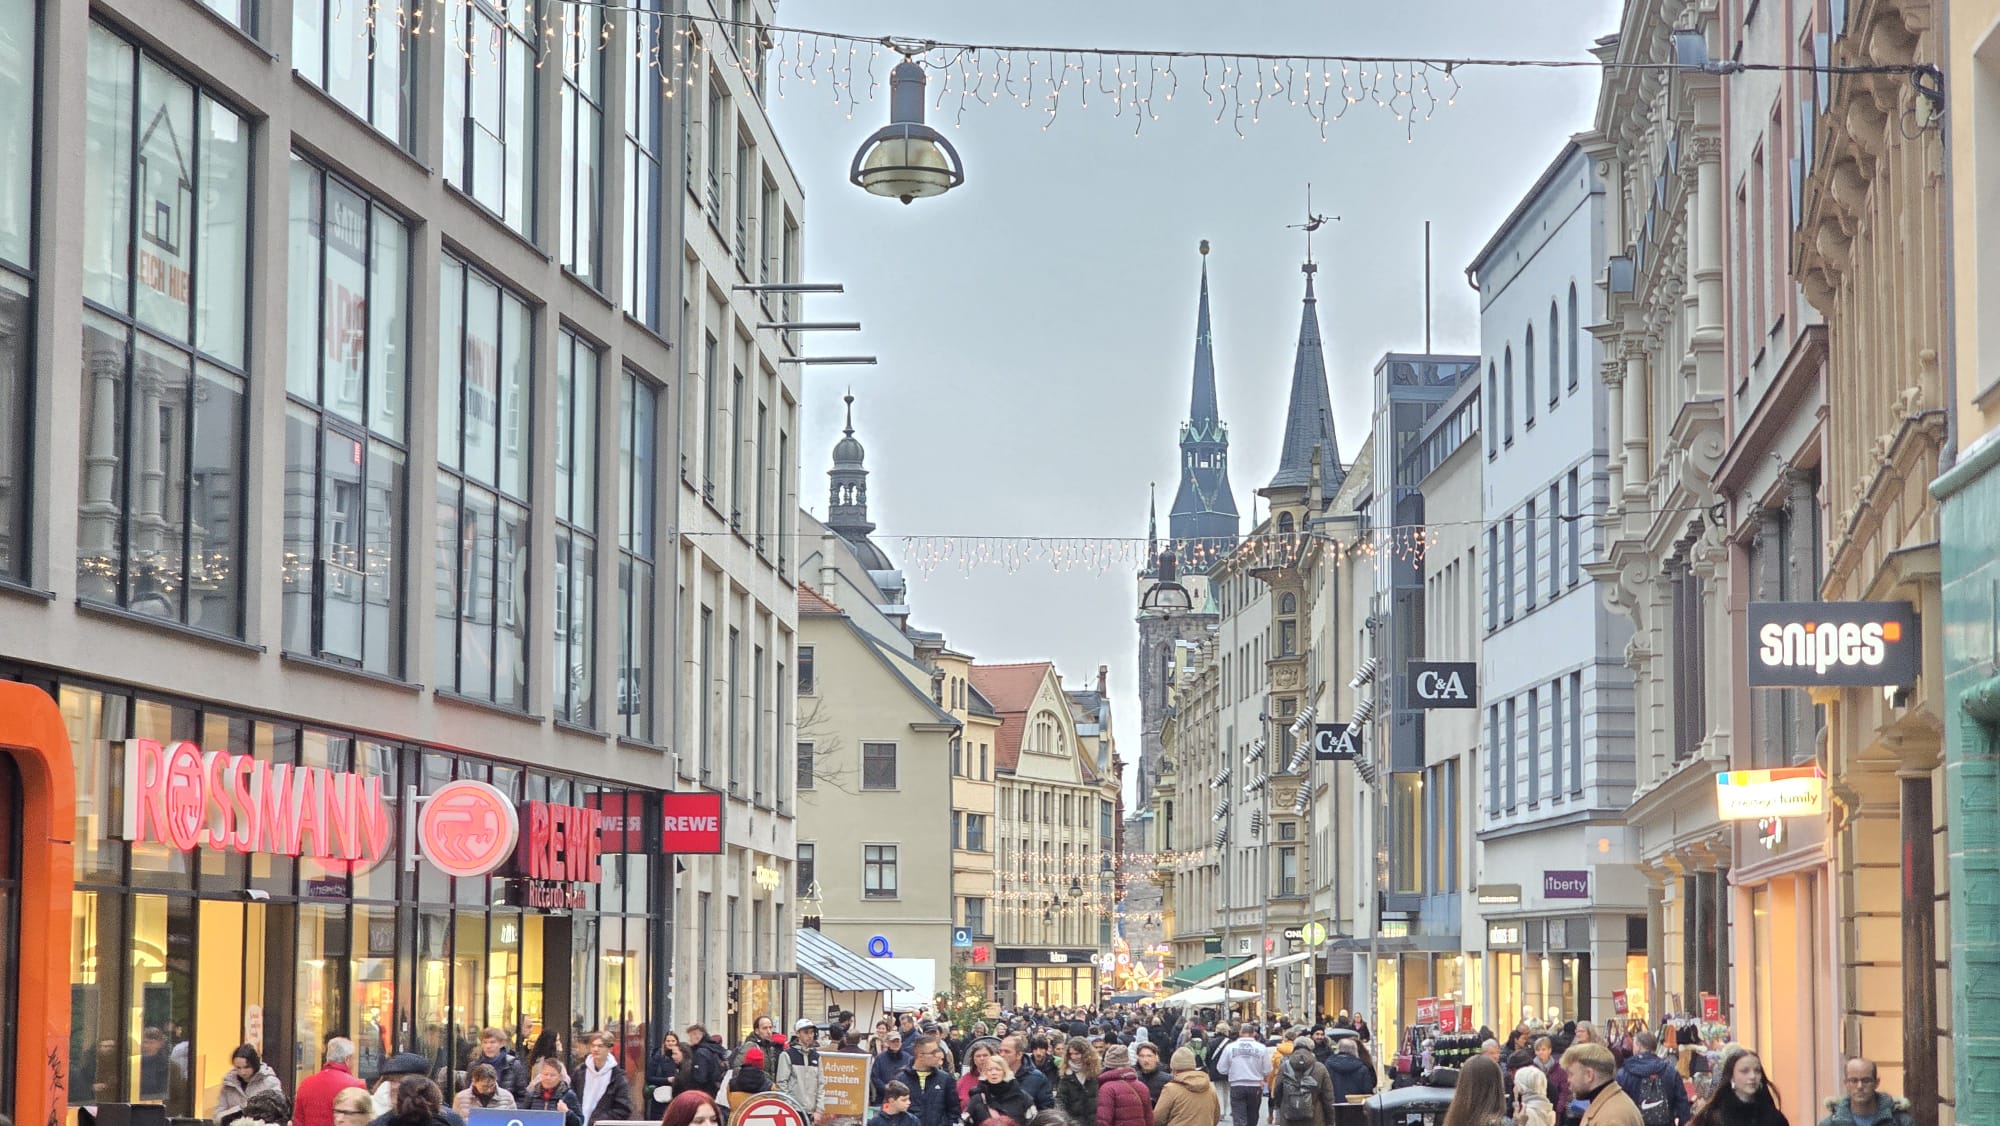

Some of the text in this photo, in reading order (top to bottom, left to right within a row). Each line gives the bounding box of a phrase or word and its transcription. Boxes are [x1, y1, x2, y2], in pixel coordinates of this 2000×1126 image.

[1760, 621, 1885, 675] snipes
[1416, 671, 1468, 699] C&A
[1315, 730, 1356, 753] C&A
[665, 816, 718, 832] REWE
[529, 799, 602, 883] REWE
[1545, 876, 1587, 893] liberty
[1284, 930, 1304, 939] ONL
[824, 1061, 858, 1073] Advent-
